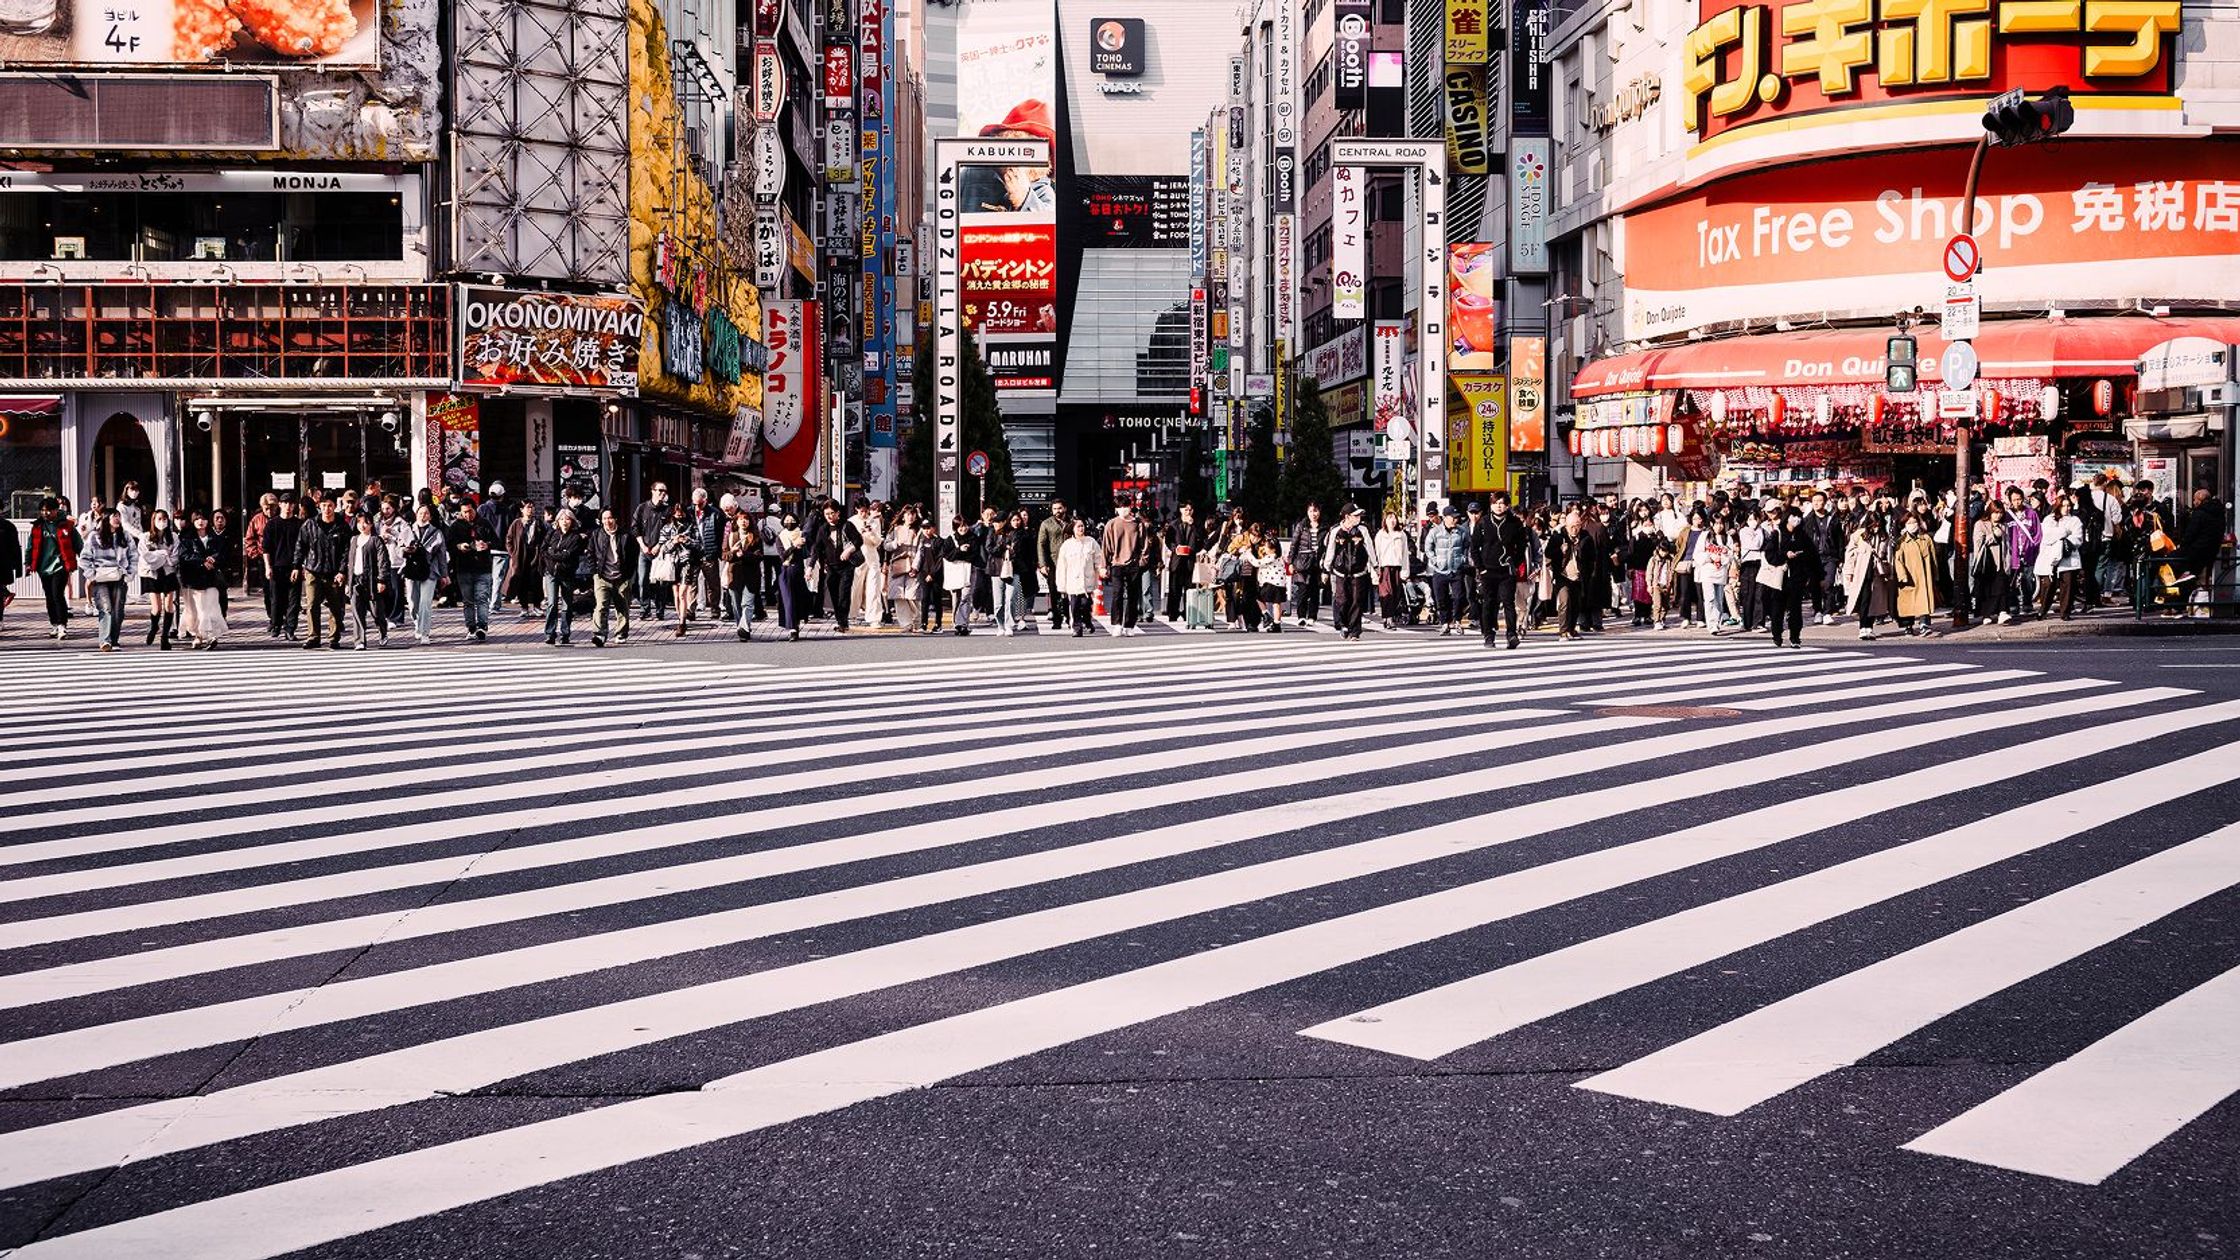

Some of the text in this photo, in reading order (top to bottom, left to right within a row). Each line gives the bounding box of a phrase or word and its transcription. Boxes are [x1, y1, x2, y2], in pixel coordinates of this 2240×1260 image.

[104, 8, 140, 21] 当ビル
[1281, 0, 1289, 40] トカフェ
[105, 25, 140, 53] 4F
[1340, 14, 1364, 88] Booth
[1448, 39, 1477, 49] スリー
[1096, 54, 1122, 62] TOHO
[1281, 59, 1289, 96] カプセル
[1446, 72, 1486, 168] CASINO
[1338, 148, 1427, 157] CENTRAL ROAD
[273, 176, 342, 190] MONJA
[1278, 154, 1294, 202] Booth
[1521, 185, 1531, 229] STAGE
[1531, 186, 1541, 220] IDOL
[1697, 180, 2240, 268] Tax Free Shop 免税店
[960, 258, 1054, 279] パディントン
[1336, 270, 1362, 289] Rio
[466, 301, 643, 338] OKONOMIYAKI
[939, 189, 955, 426] GODZILLA ROAD
[986, 301, 1027, 318] 5.9 Fri
[1427, 211, 1442, 408] ゴジラロード
[1646, 305, 1686, 325] Don Quijote
[986, 319, 1027, 327] ロードショー
[475, 334, 627, 371] お好み焼き
[768, 309, 787, 393] トラノコ
[990, 350, 1051, 367] MARUHAN
[1382, 366, 1394, 392] 九十九
[1784, 359, 1833, 378] Don
[1463, 381, 1503, 393] カラオケ
[1519, 389, 1536, 398] 食べ
[1119, 418, 1151, 428] TOHO
[1482, 420, 1495, 482] 持込OK!
